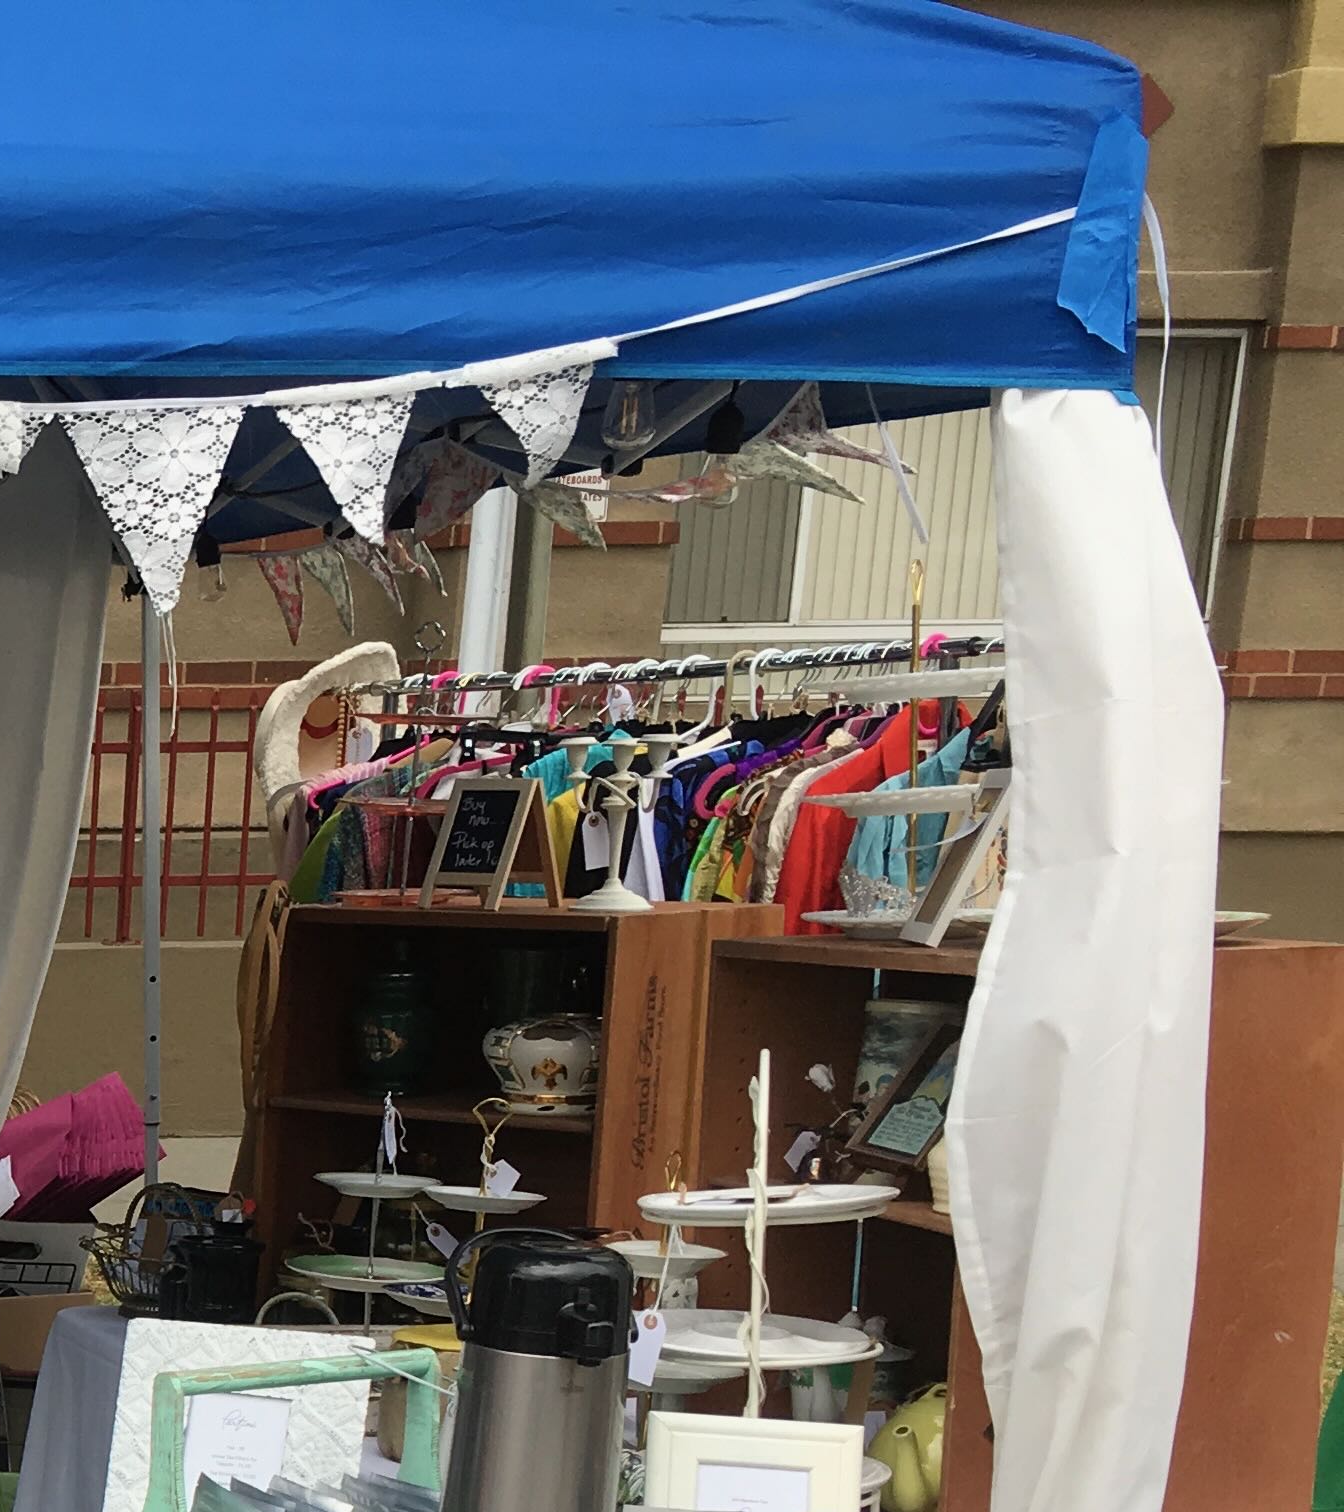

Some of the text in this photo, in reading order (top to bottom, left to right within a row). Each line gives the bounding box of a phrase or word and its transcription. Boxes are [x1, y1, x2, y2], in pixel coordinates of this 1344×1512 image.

[461, 797, 486, 814] Buy
[452, 831, 479, 849] Pick
[631, 975, 658, 1170] Bristol Farms
